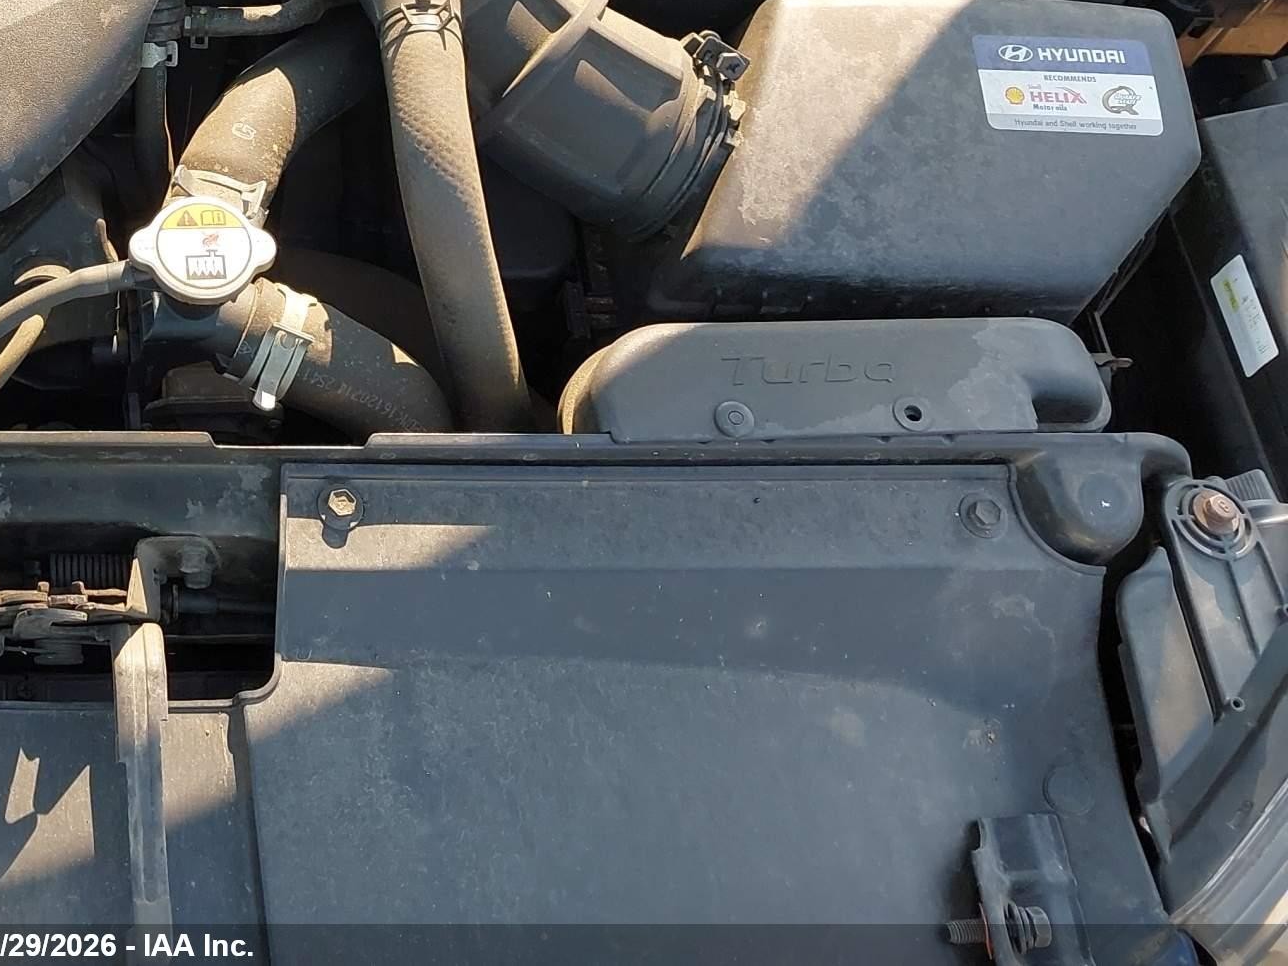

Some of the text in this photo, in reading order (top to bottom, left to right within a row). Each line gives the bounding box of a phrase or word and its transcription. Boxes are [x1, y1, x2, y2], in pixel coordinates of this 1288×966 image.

[1037, 46, 1127, 65] HYUNDAI
[1043, 74, 1097, 83] RECOMMENDS
[1030, 88, 1087, 104] HELIX
[1014, 118, 1043, 128] Hyundai
[1045, 119, 1058, 127] and
[1060, 120, 1077, 128] Shell
[1079, 121, 1107, 130] working
[720, 353, 896, 386] Turbo
